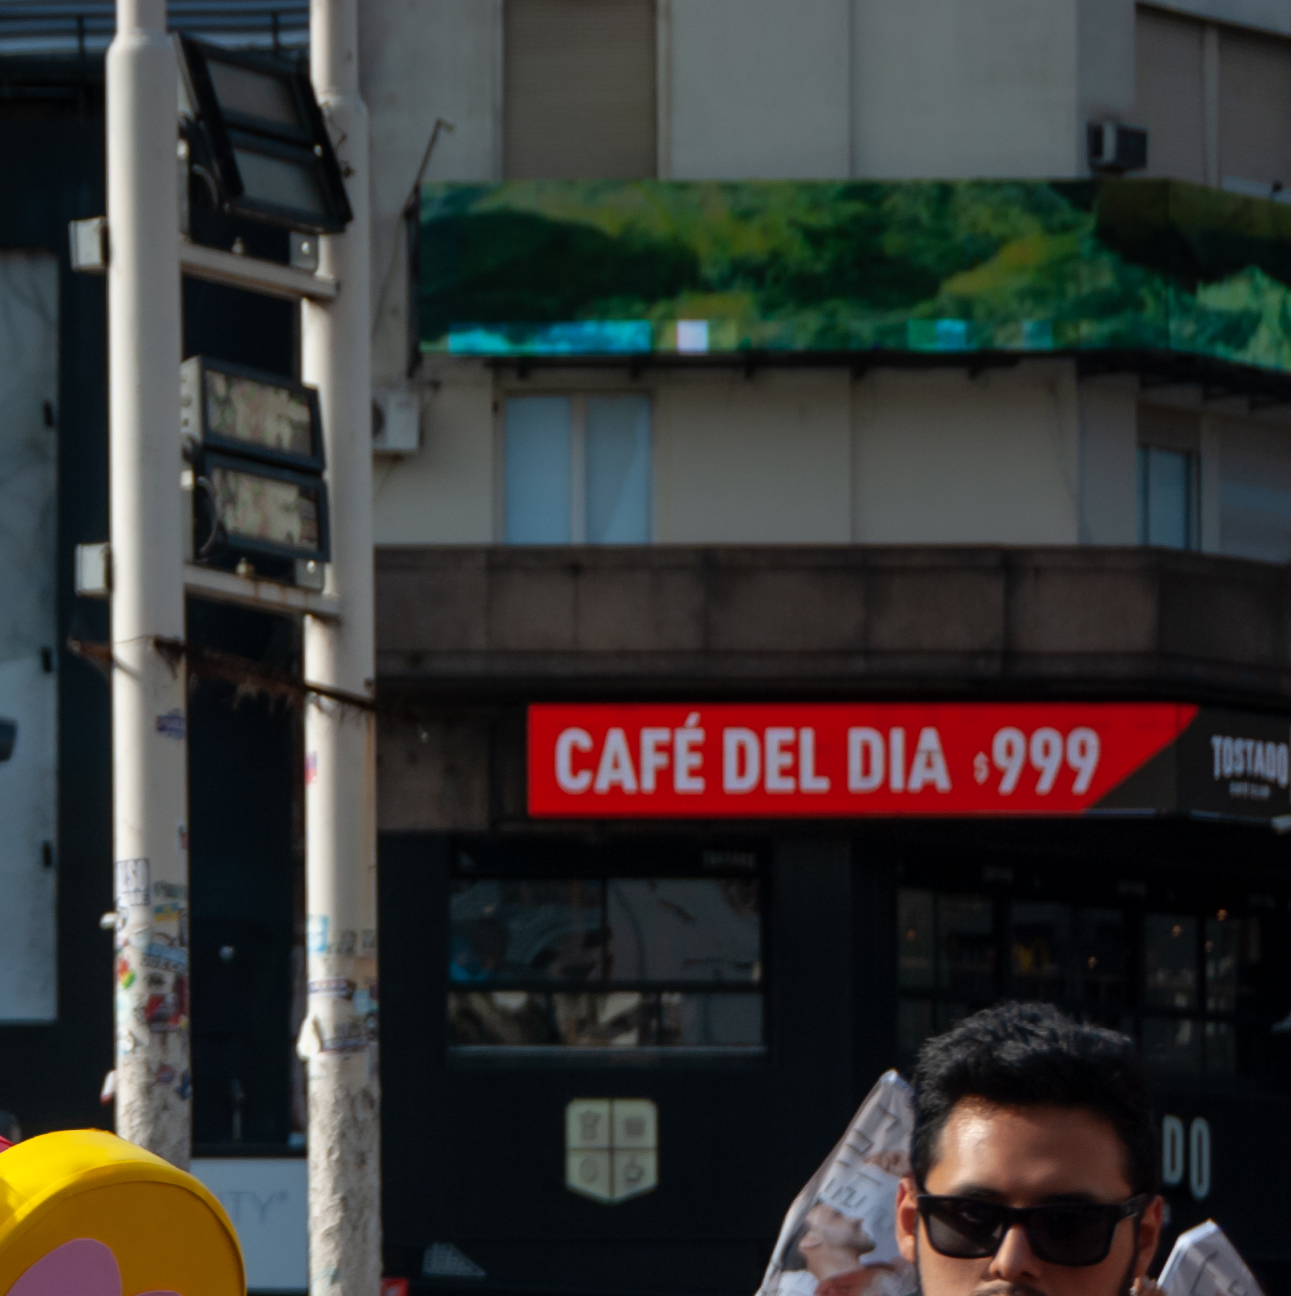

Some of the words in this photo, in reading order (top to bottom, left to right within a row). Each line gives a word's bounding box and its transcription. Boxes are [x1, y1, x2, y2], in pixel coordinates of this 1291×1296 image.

[553, 711, 707, 796] CAFÉ
[722, 726, 831, 795] DEL
[846, 726, 953, 795] DIA
